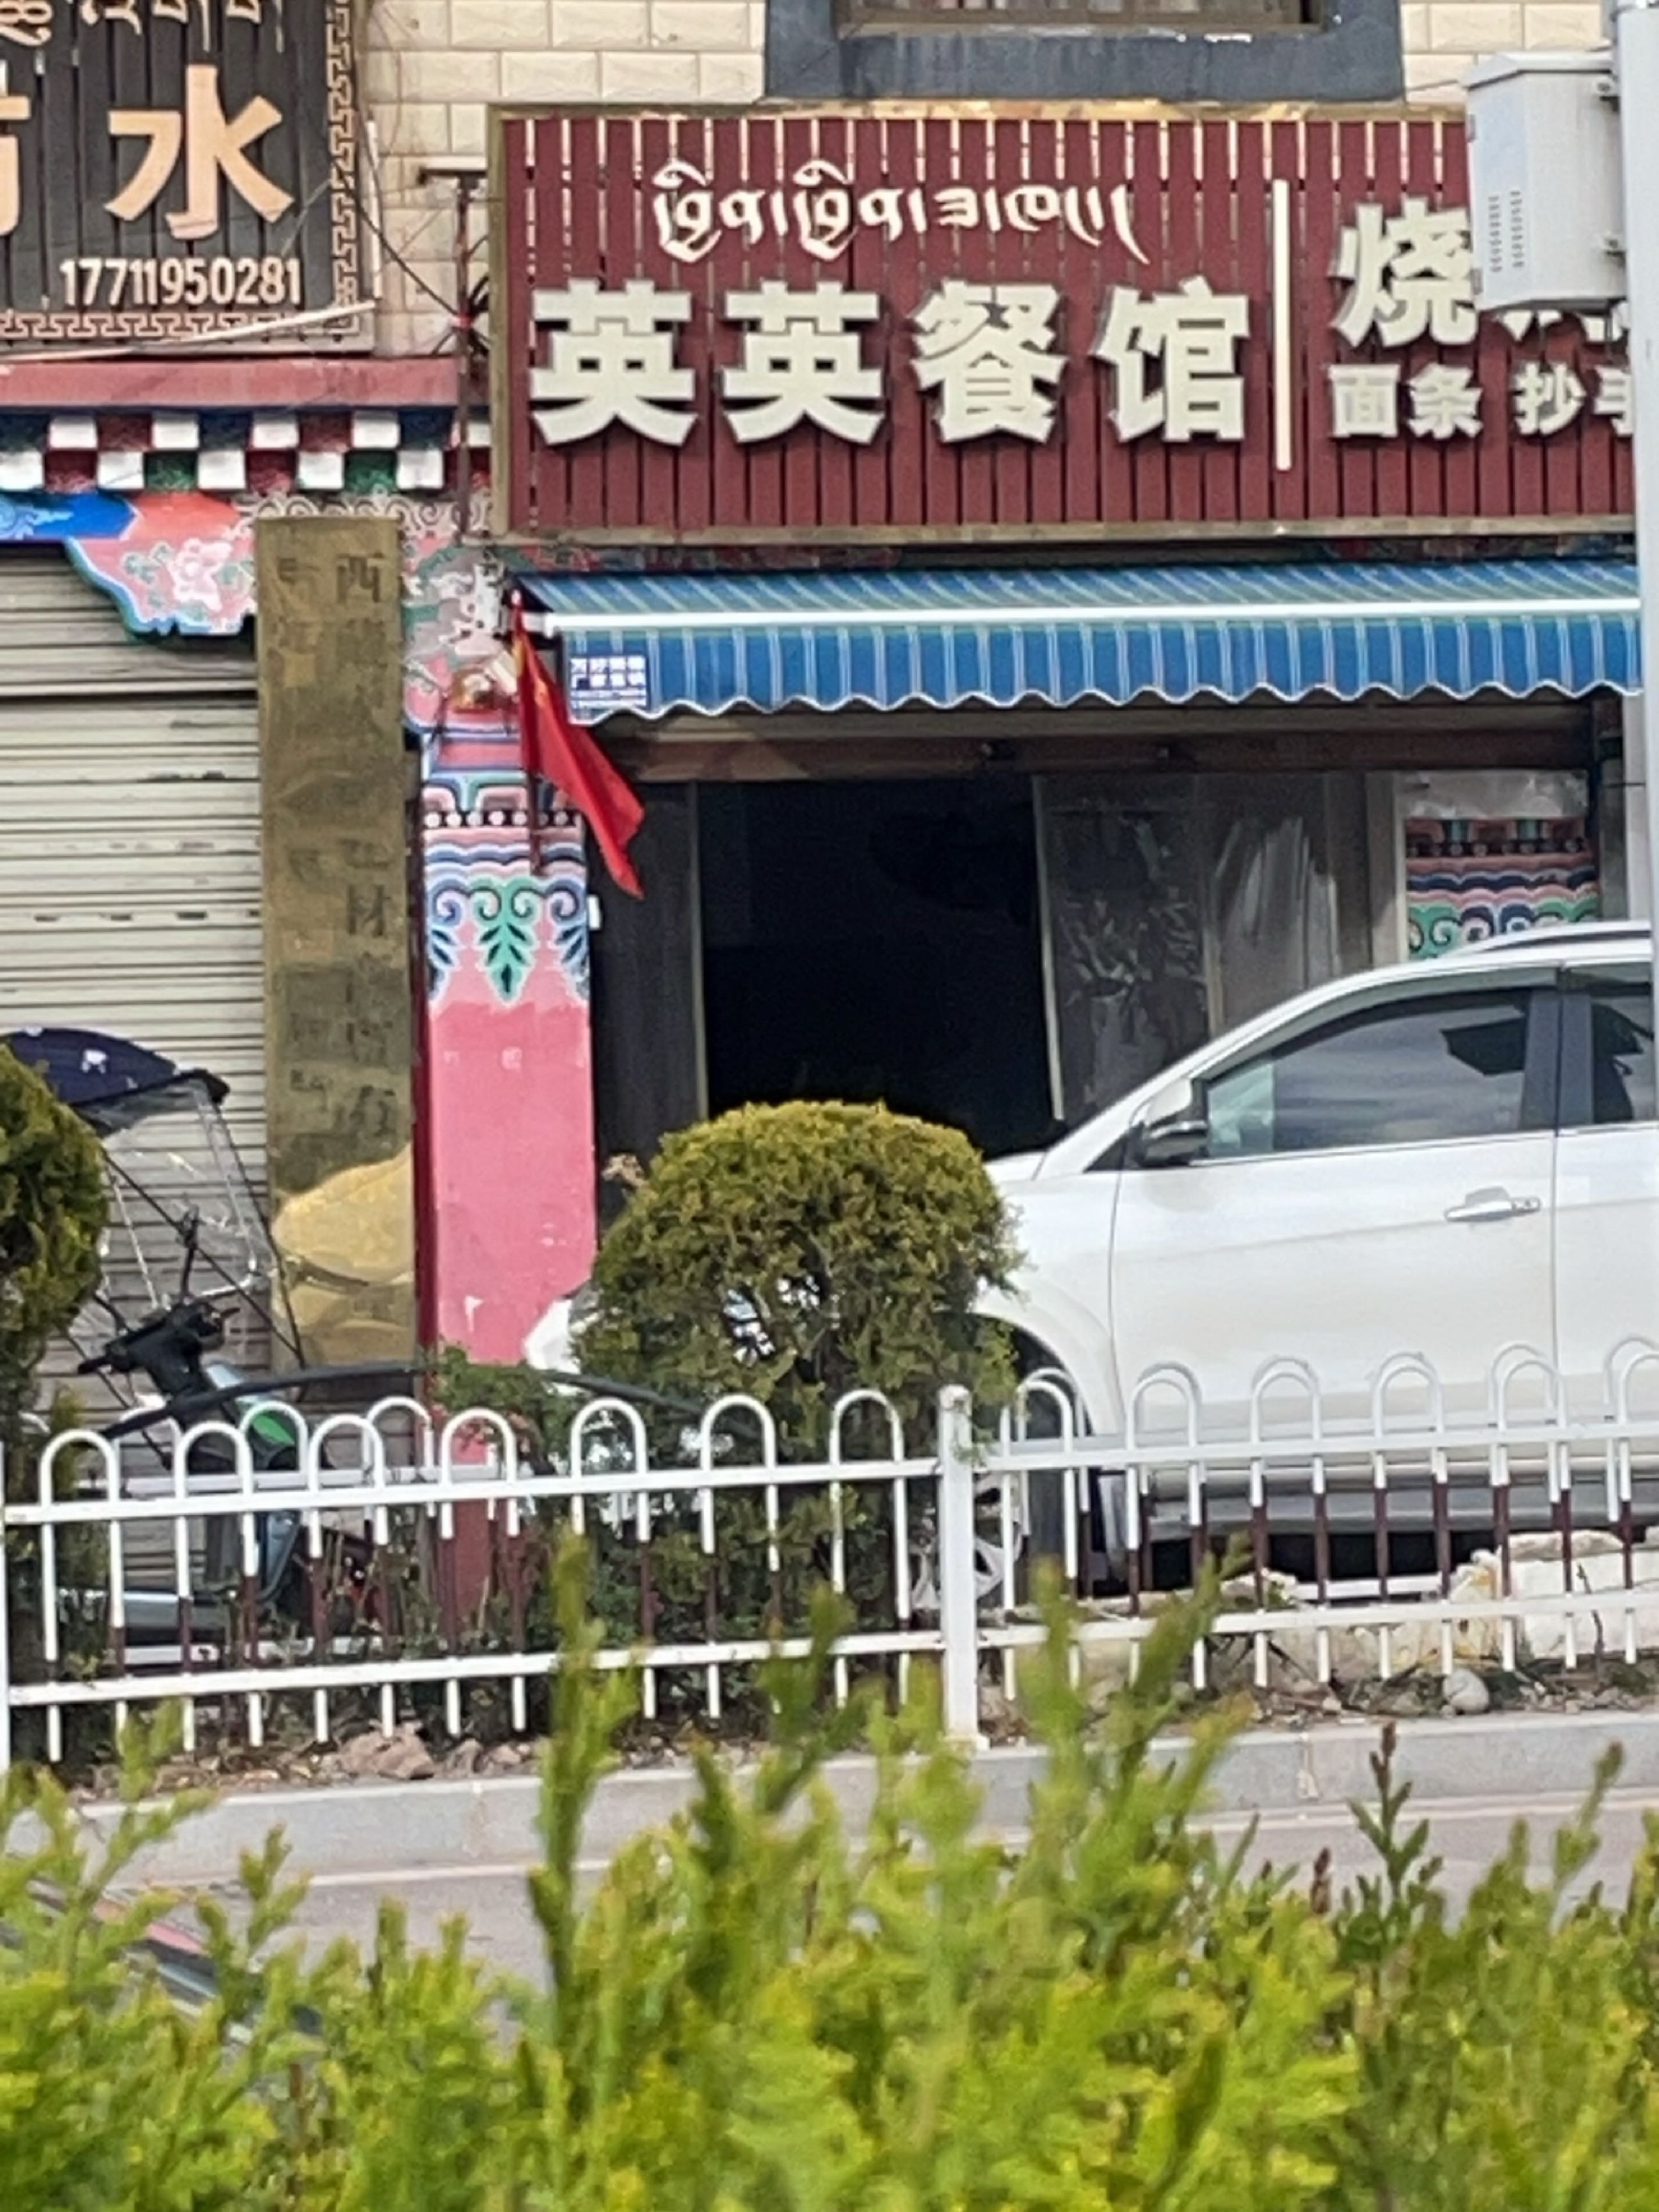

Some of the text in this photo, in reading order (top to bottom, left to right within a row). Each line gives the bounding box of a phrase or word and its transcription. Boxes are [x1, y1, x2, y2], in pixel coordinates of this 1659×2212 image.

[60, 258, 301, 305] 17711950281
[529, 277, 1251, 445] 英英餐馆
[1327, 363, 1485, 442] 面条
